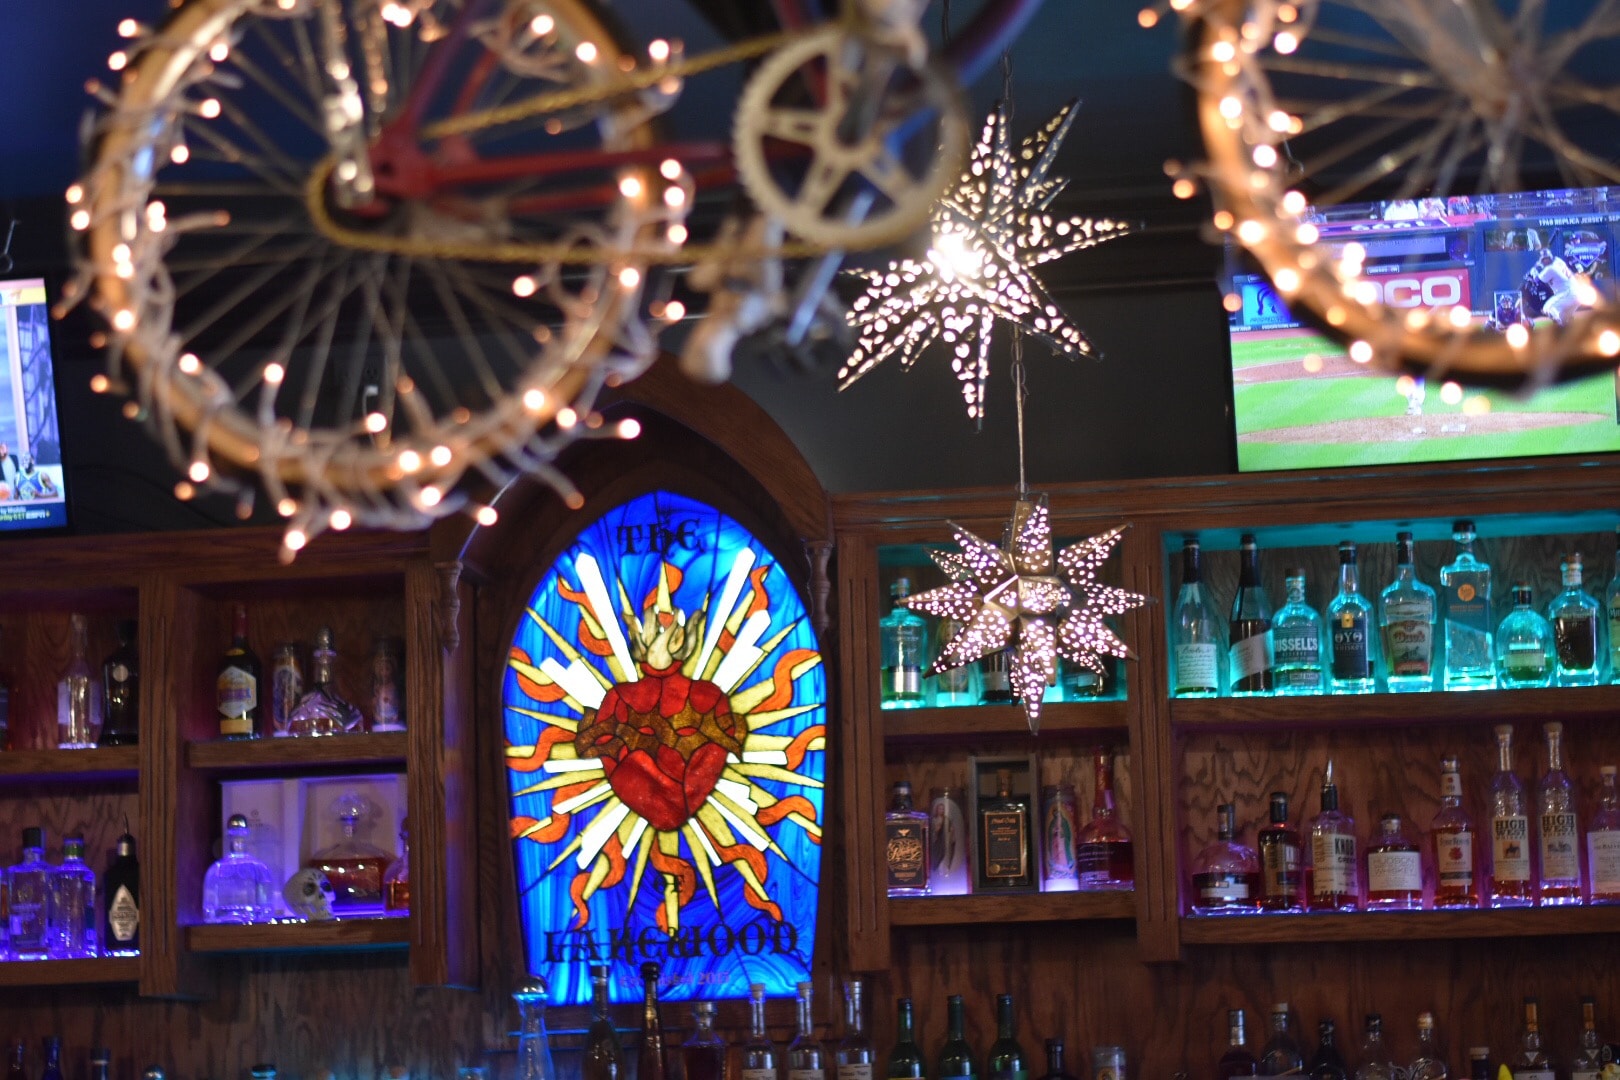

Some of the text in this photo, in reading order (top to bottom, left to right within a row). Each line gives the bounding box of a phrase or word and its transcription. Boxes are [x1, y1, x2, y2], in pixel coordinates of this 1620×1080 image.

[1495, 819, 1526, 830] HIGH
[1542, 814, 1575, 827] HIGH
[1495, 829, 1526, 837] WEST
[1542, 825, 1575, 833] WEST
[543, 920, 799, 964] LAKEWOOD
